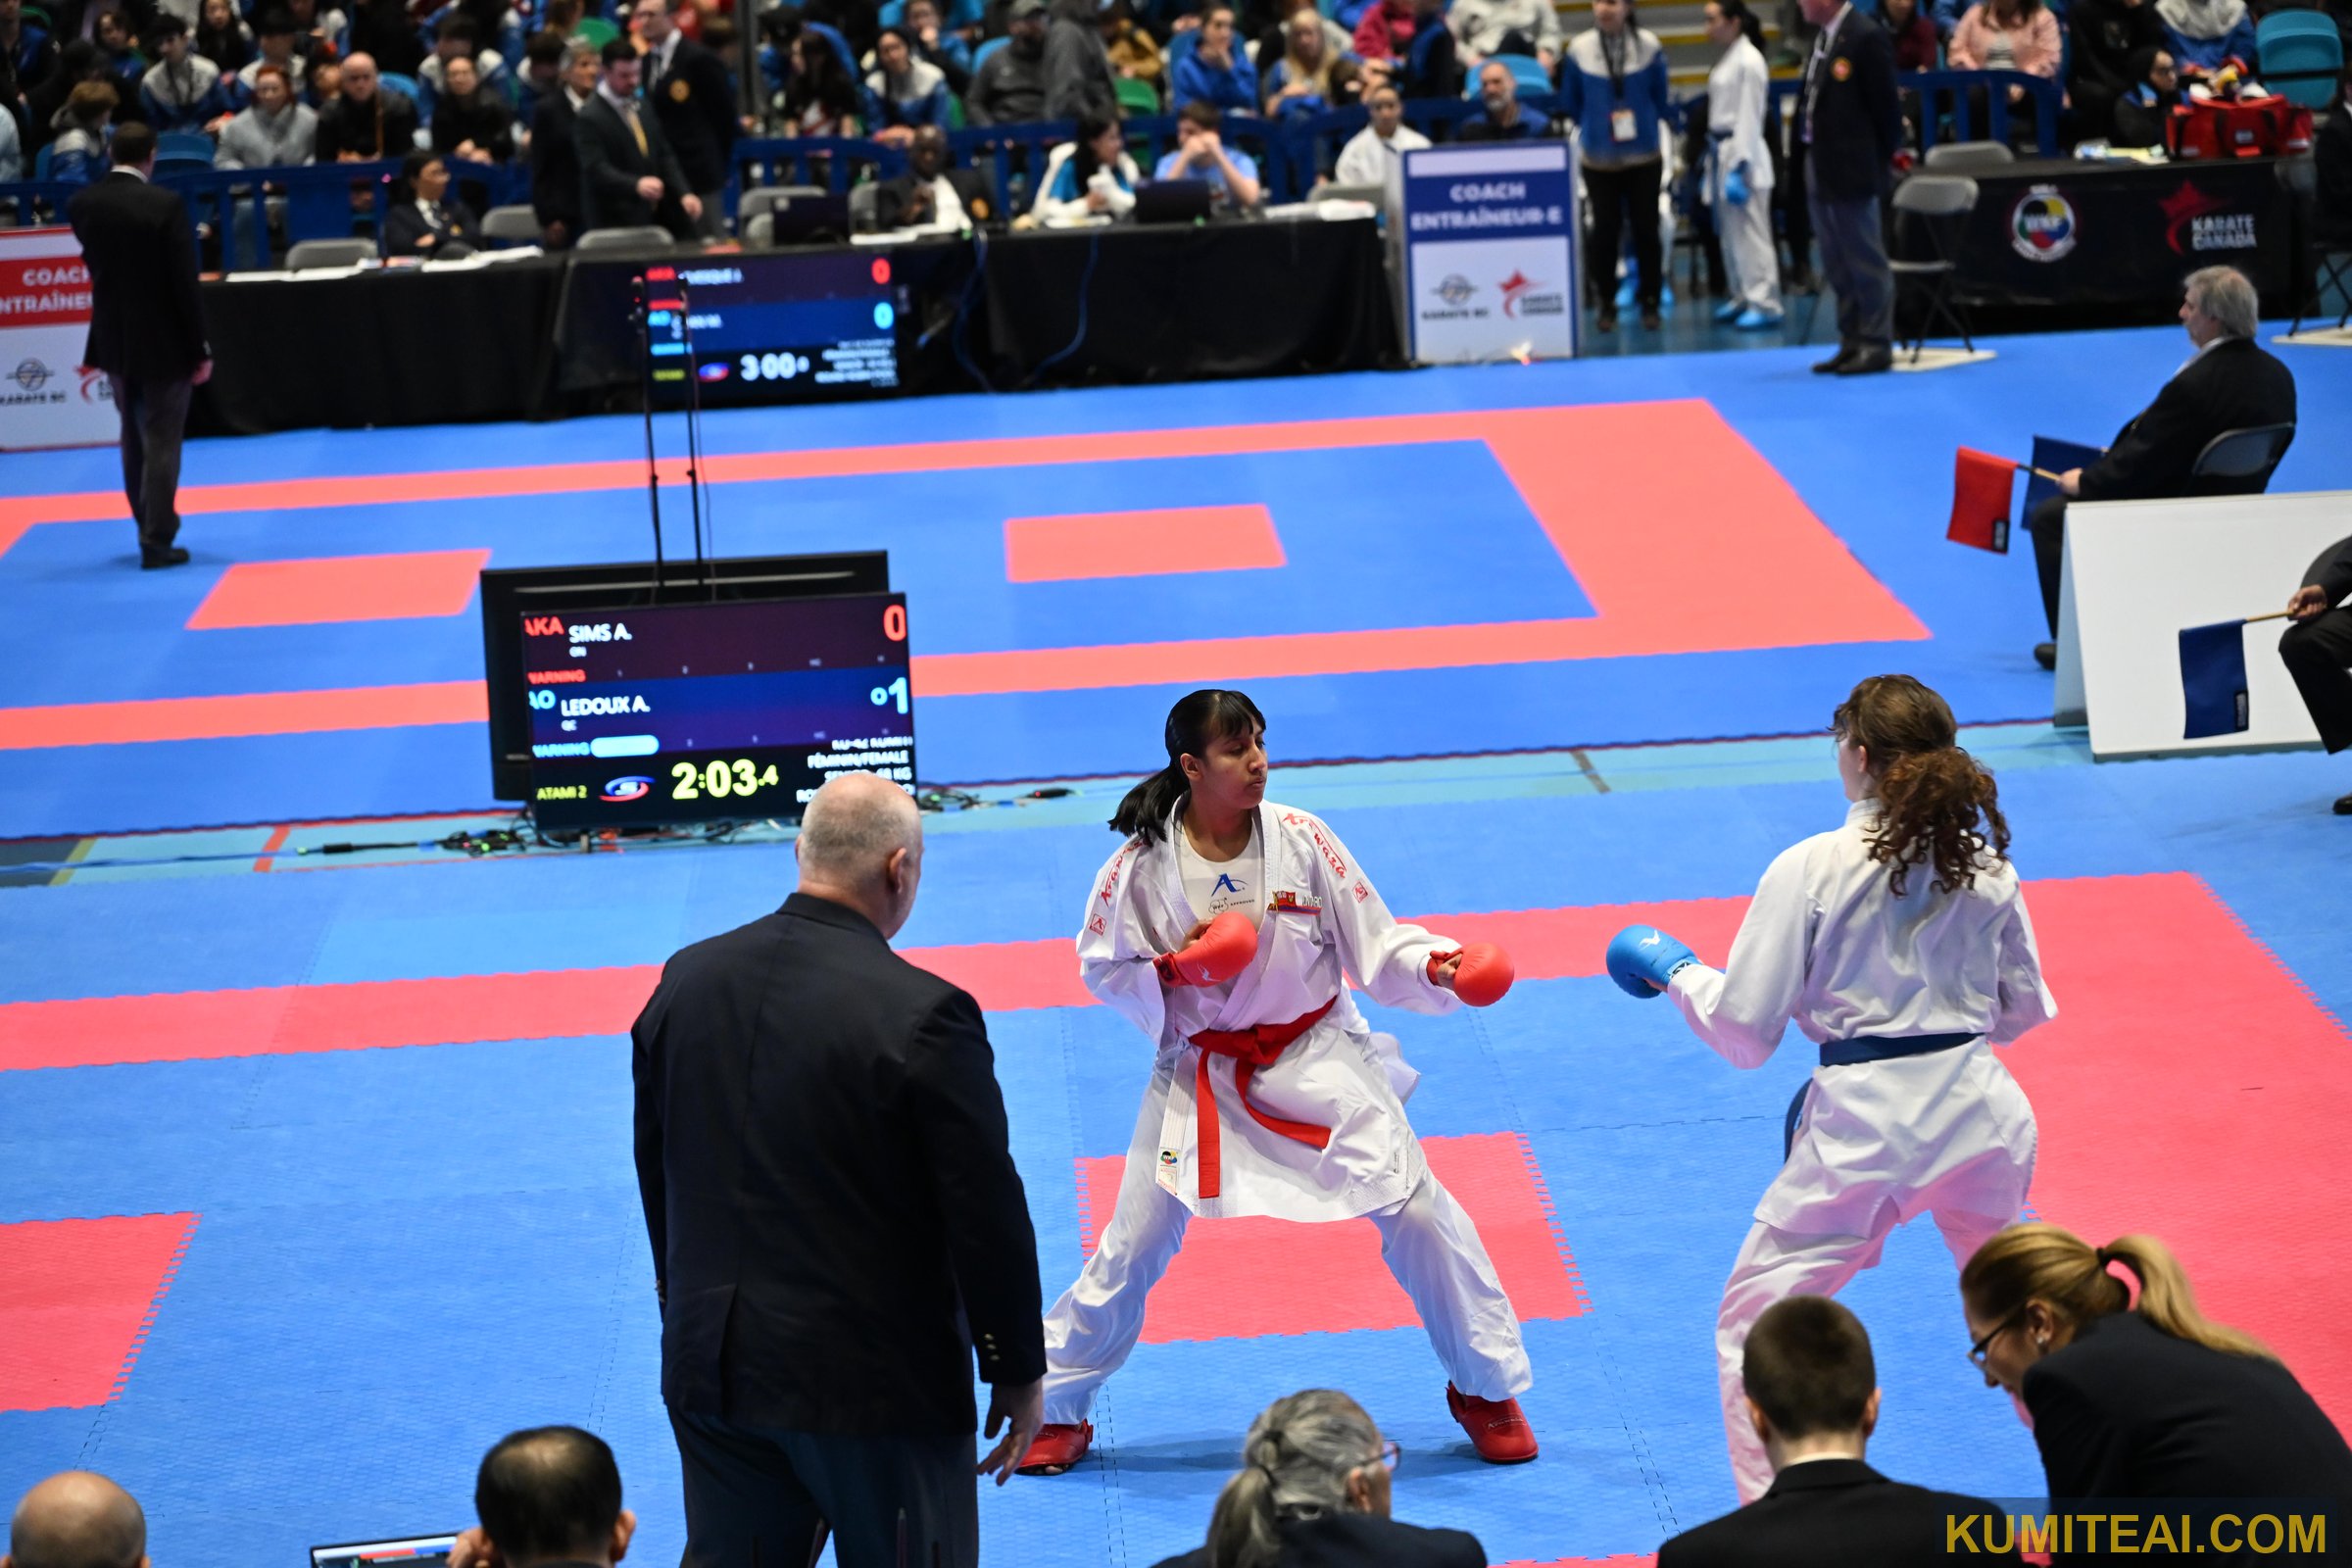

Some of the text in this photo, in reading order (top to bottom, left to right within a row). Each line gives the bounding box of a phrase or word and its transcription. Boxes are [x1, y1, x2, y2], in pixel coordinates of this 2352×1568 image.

[1448, 181, 1526, 203] COACH
[2191, 214, 2254, 232] KARATE
[2191, 232, 2257, 250] CANADA
[871, 258, 891, 284] 0
[0, 291, 93, 314] NTRAÎNE
[873, 302, 894, 329] 0
[568, 622, 633, 643] SIMS A.
[883, 604, 907, 641] 0
[561, 695, 651, 716] LEDOUX A.
[671, 759, 779, 800] 2:03.4
[893, 766, 912, 780] KG
[578, 785, 587, 799] 2
[1101, 840, 1151, 907] Arawaz
